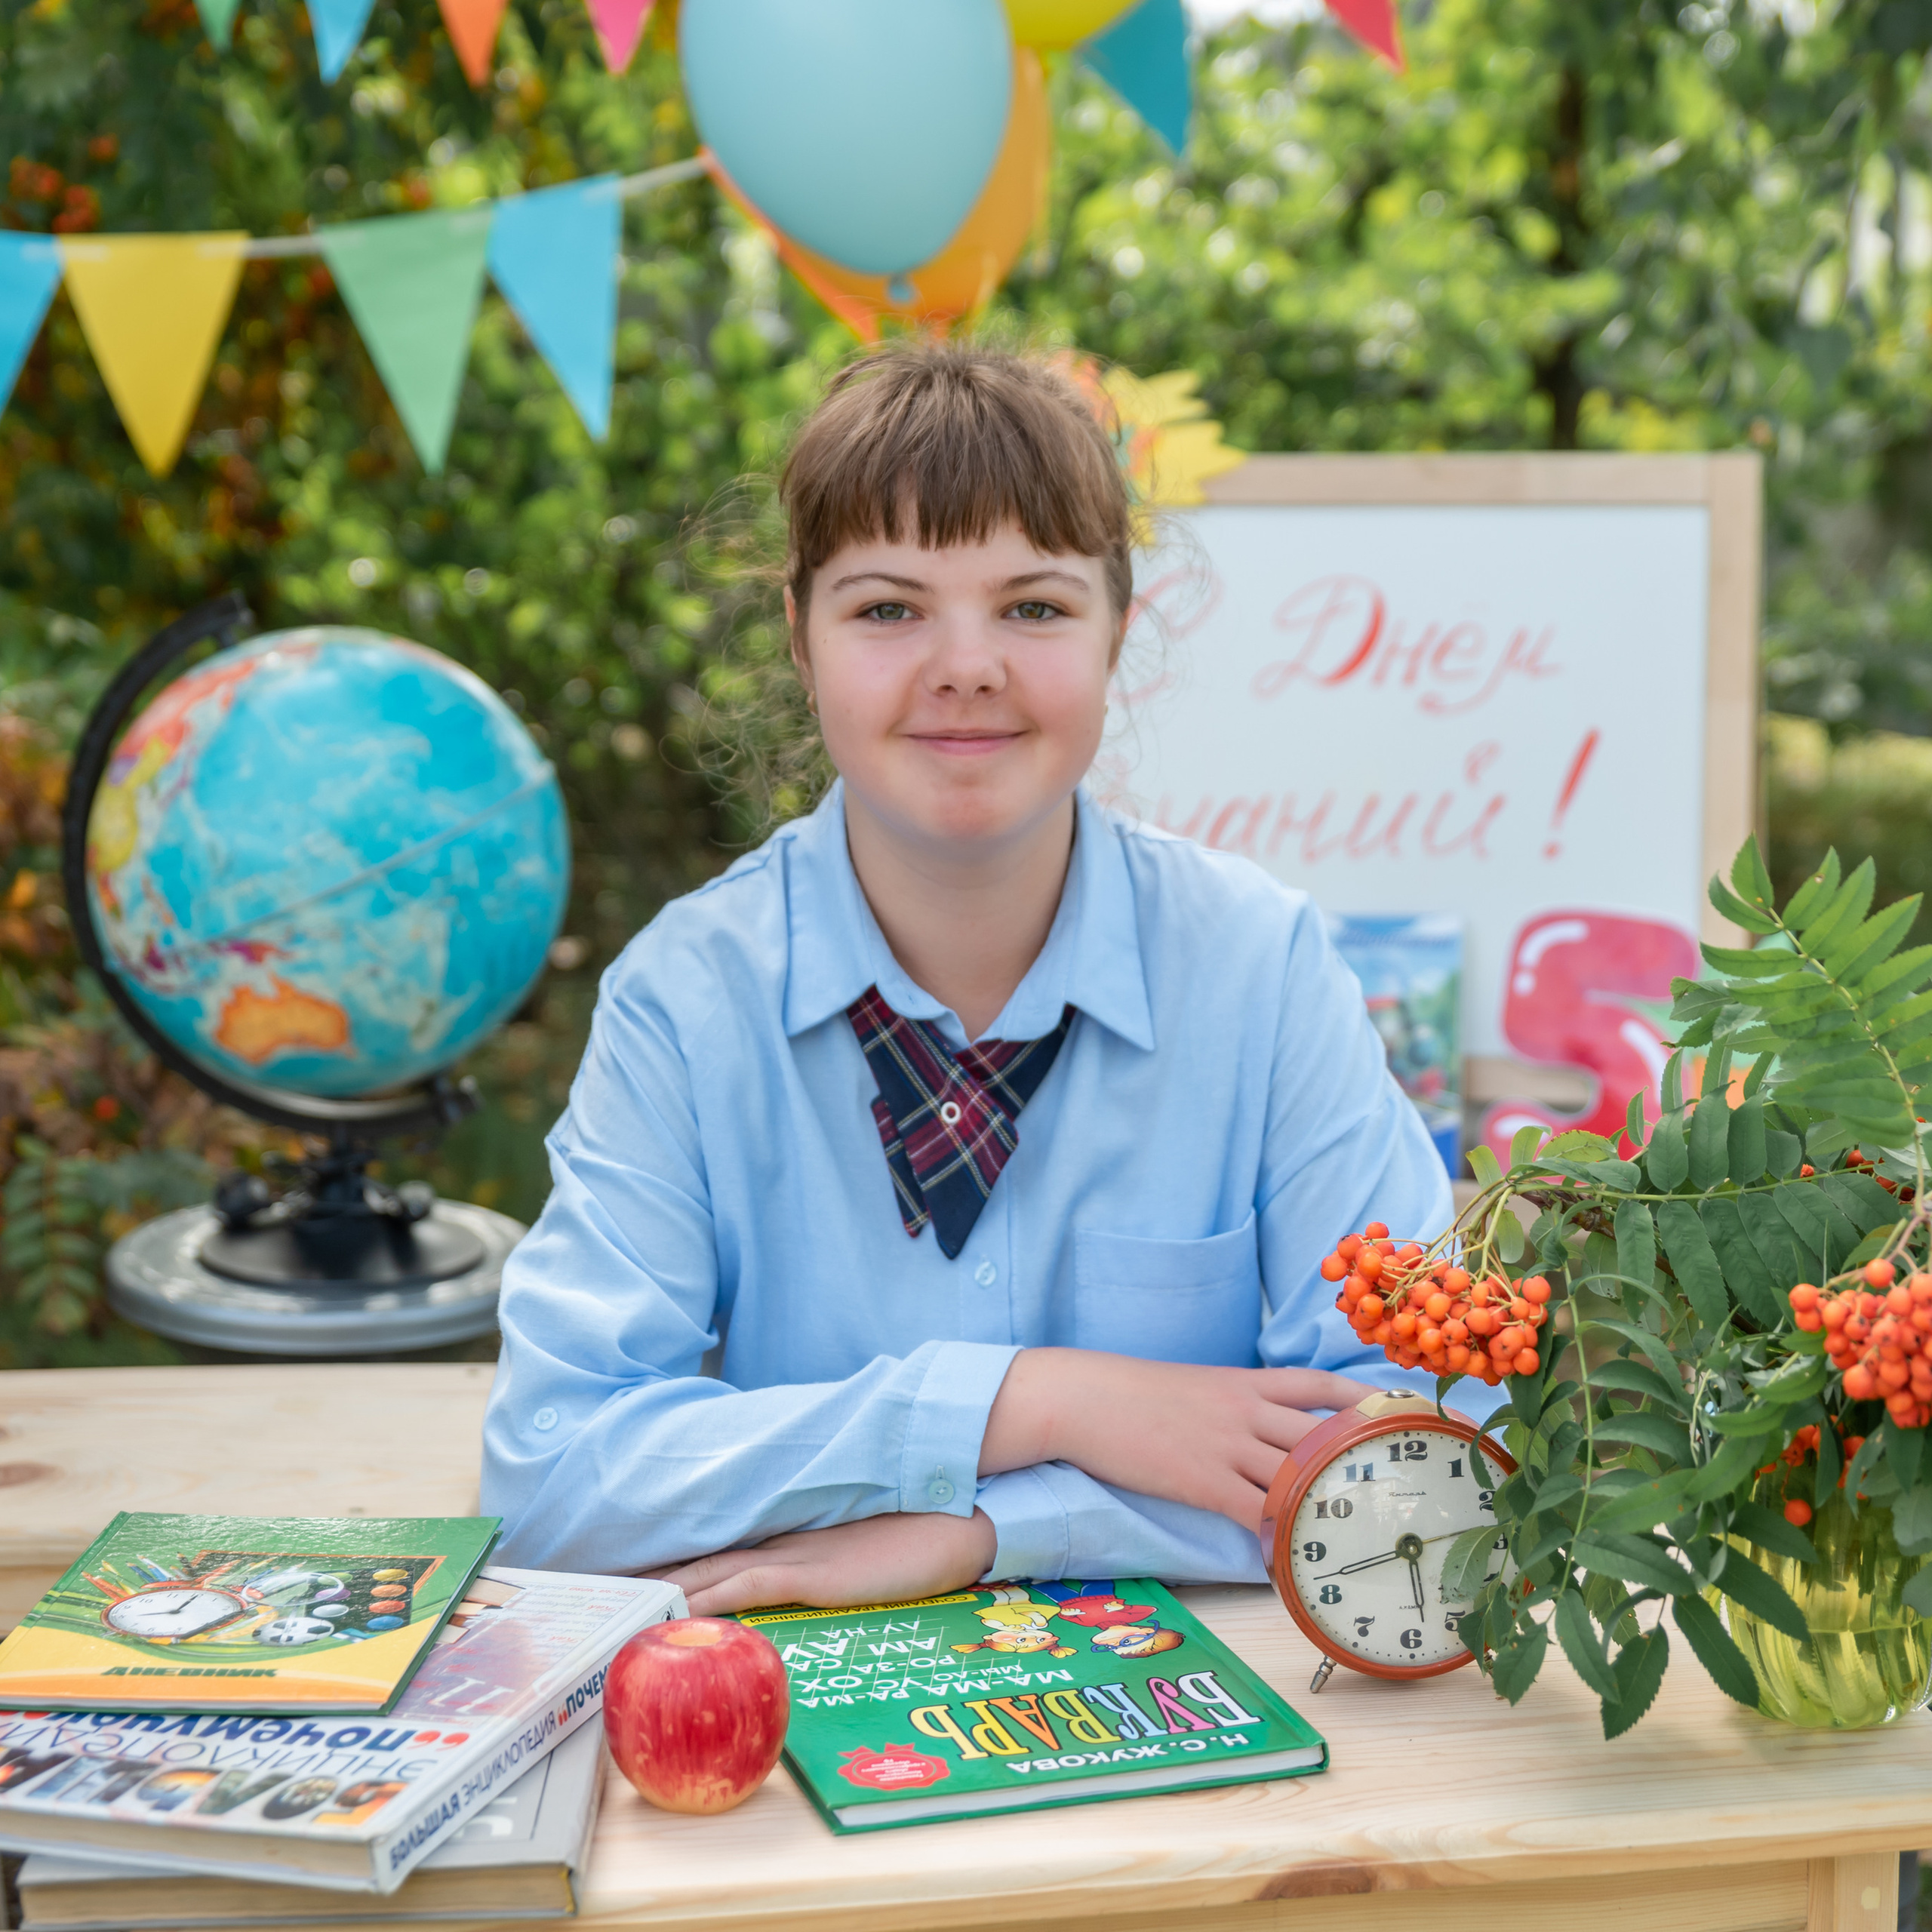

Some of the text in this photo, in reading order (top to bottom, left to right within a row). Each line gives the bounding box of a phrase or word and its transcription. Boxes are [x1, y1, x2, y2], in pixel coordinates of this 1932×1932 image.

[1386, 1440, 1428, 1462] 12
[1343, 1462, 1376, 1482] 11
[1447, 1458, 1464, 1478] 1
[1314, 1498, 1353, 1519] 10
[1478, 1491, 1496, 1511] 2
[1303, 1541, 1327, 1562] 9
[1319, 1584, 1343, 1605] 8
[750, 1595, 968, 1623] СОЧЕТАНИЕ ТРАДИЦИОННОЙ
[820, 1620, 919, 1638] ЛУ-НА
[1353, 1616, 1375, 1637] 7
[1444, 1611, 1466, 1632] 5
[780, 1637, 937, 1662] АМ АУ
[1400, 1629, 1423, 1649] 6
[100, 1666, 279, 1678] ДНЕВНИК
[786, 1654, 956, 1673] РО-ЗА СА
[794, 1665, 1023, 1693] МЫ-ЛО УС ОХ
[796, 1669, 1073, 1708] МА-МА РА-МА
[907, 1670, 1266, 1761] БУКВАРЬ
[389, 1792, 461, 1872] БОЛЬШАЯ
[460, 1710, 557, 1807] ЭНЦИКЛОПЕДИЯ
[558, 1662, 611, 1727] “ПОЧЕМ
[0, 1747, 410, 1826] БОЛЬША
